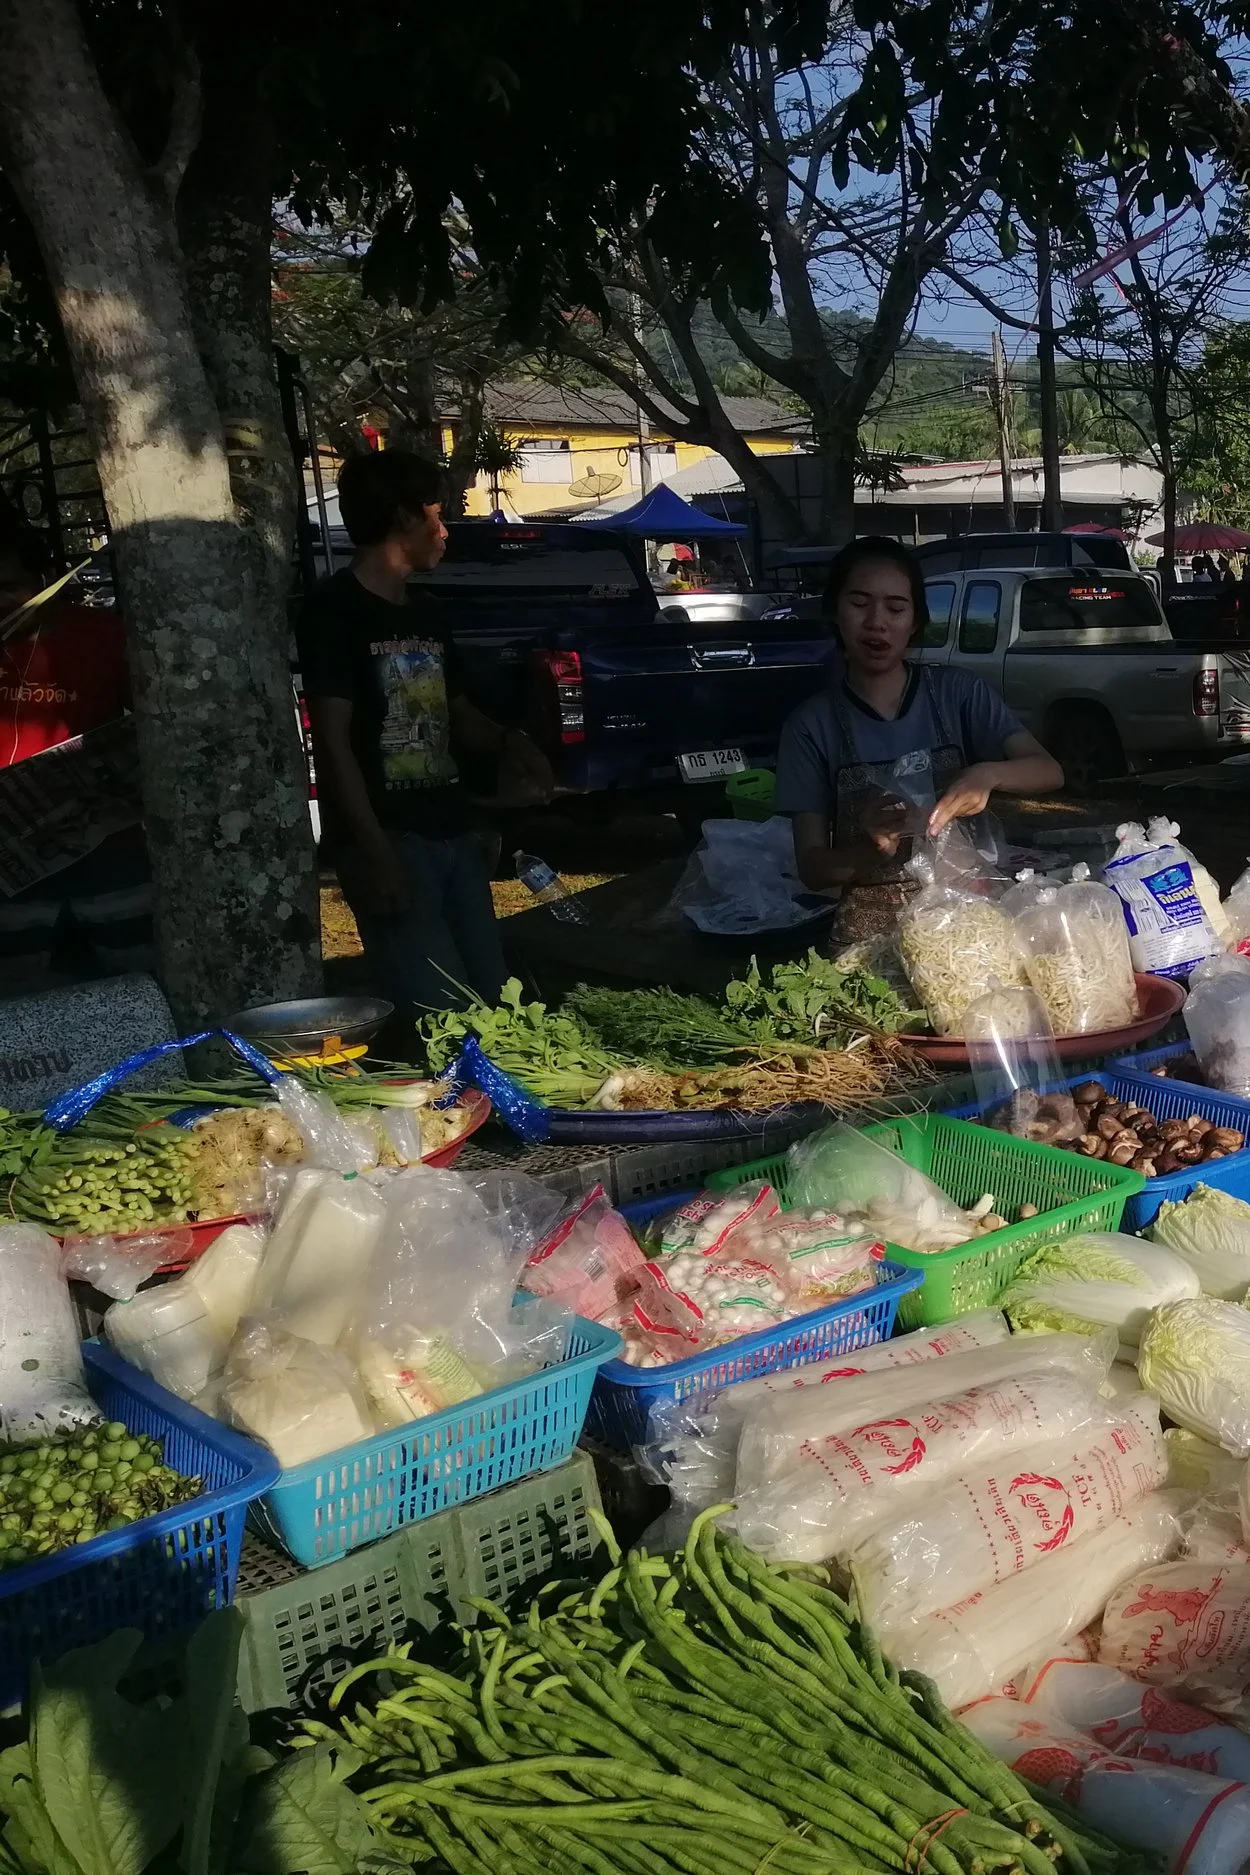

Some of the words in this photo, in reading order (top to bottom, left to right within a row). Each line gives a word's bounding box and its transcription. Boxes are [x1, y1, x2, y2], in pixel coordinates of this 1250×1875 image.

[689, 753, 707, 768] กธ
[712, 750, 741, 765] 1243
[1073, 1472, 1097, 1509] TCF
